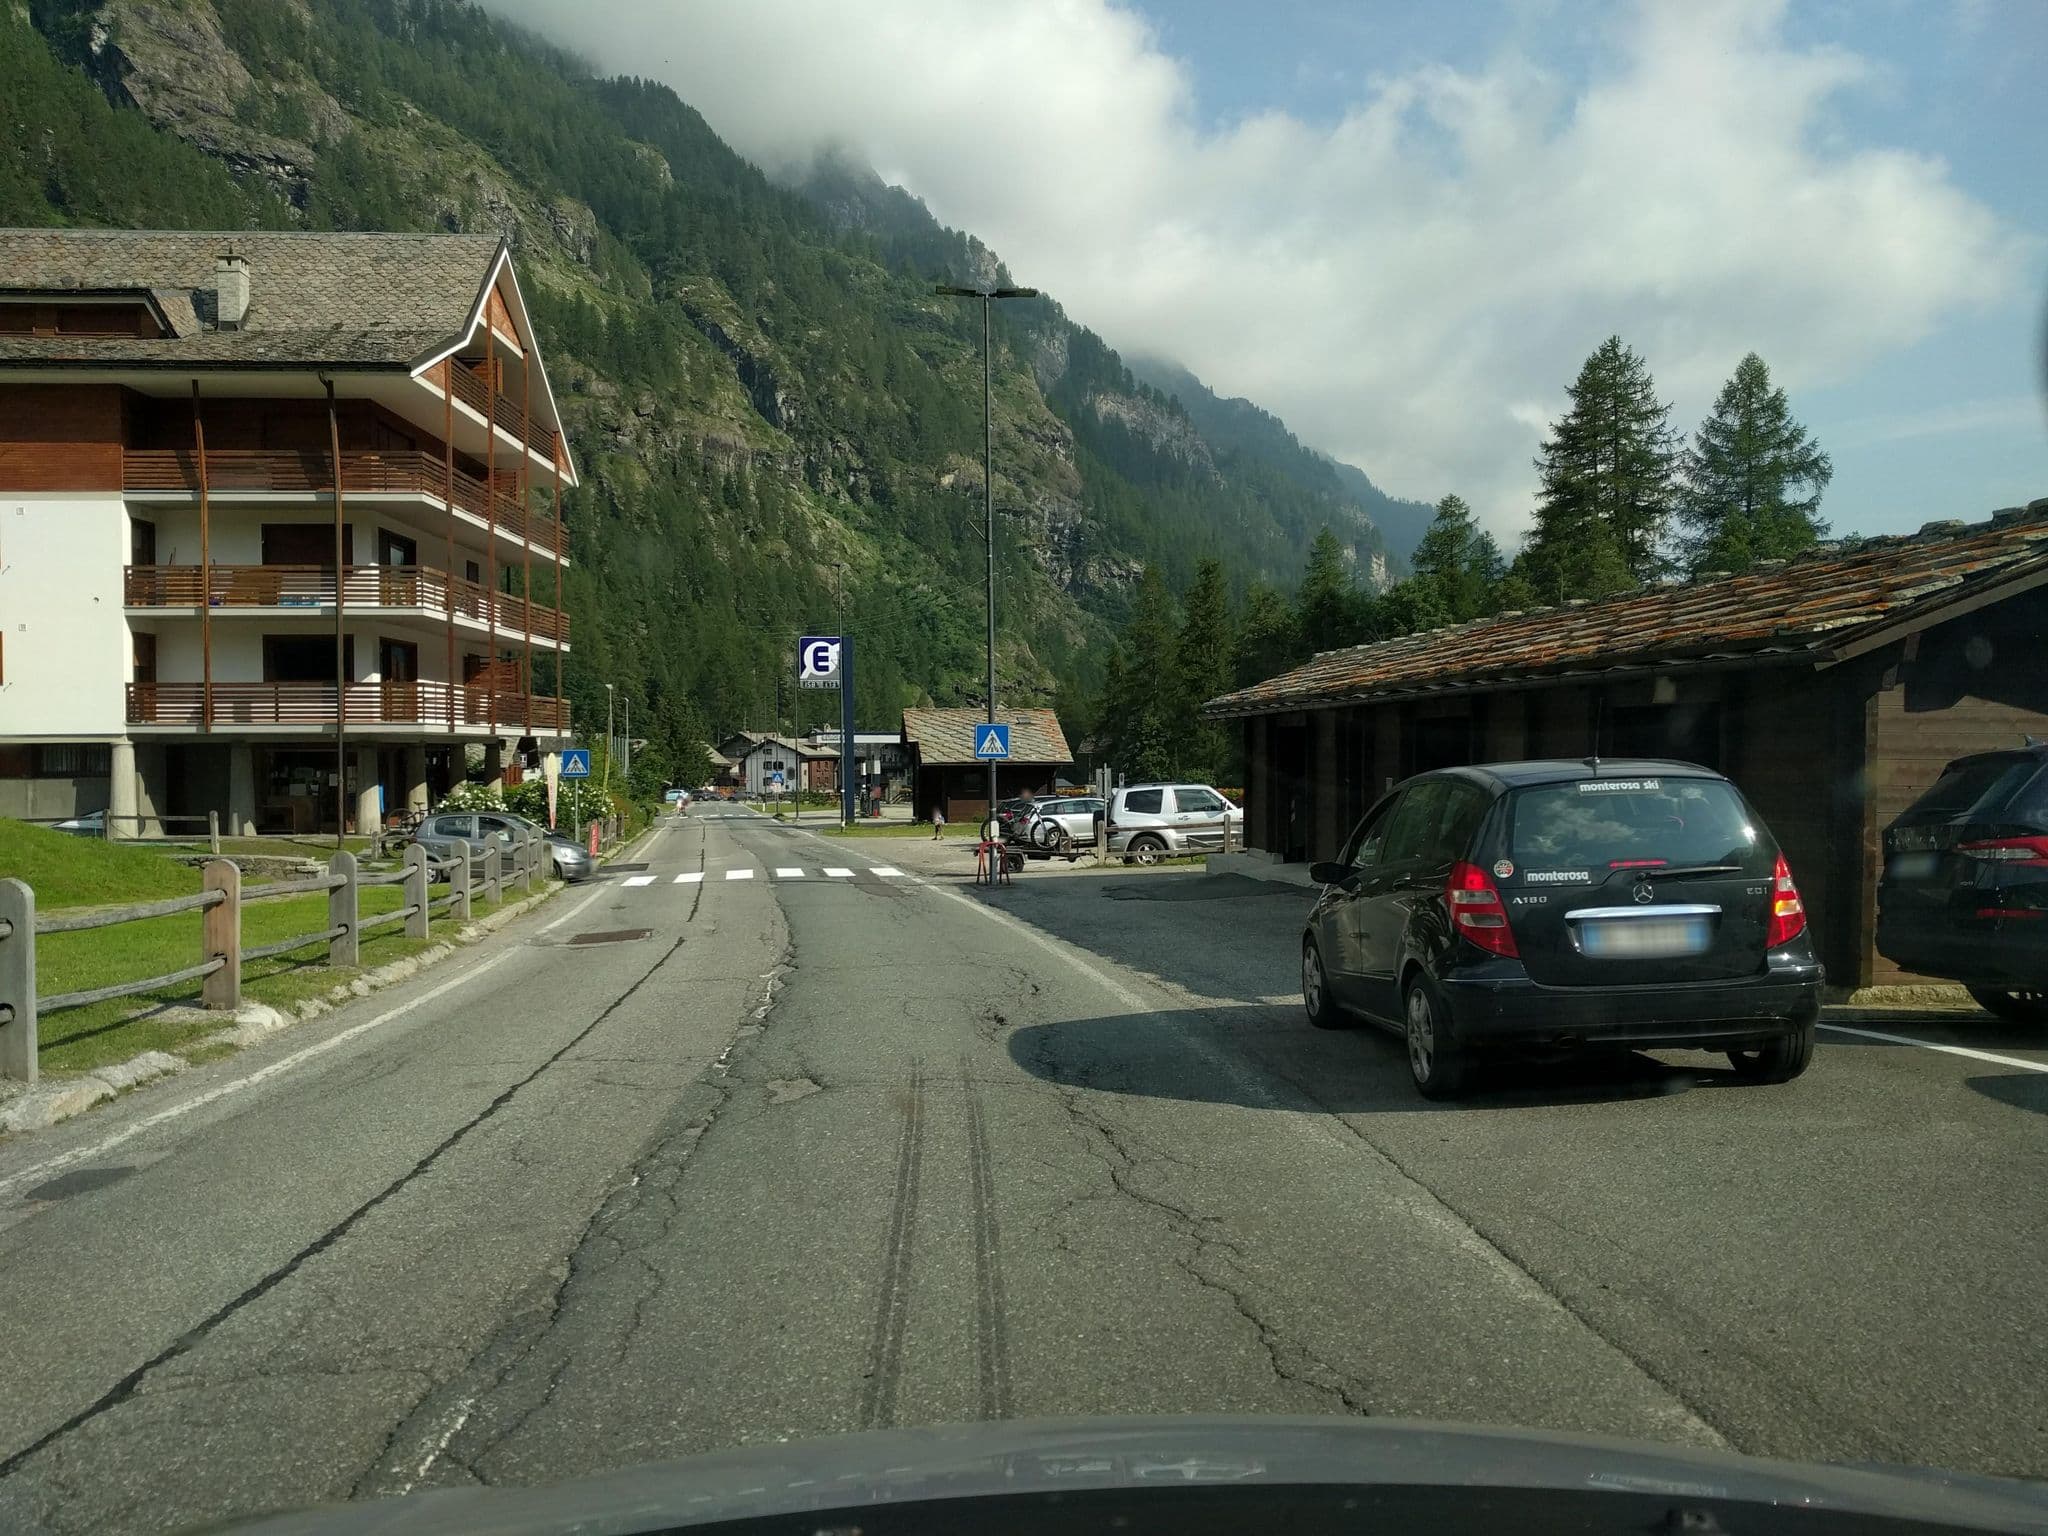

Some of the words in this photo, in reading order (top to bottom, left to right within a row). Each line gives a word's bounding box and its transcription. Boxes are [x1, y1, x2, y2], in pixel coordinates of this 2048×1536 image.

[1580, 782, 1640, 792] monterosa
[1643, 780, 1659, 789] ski
[1527, 871, 1589, 882] monterosa
